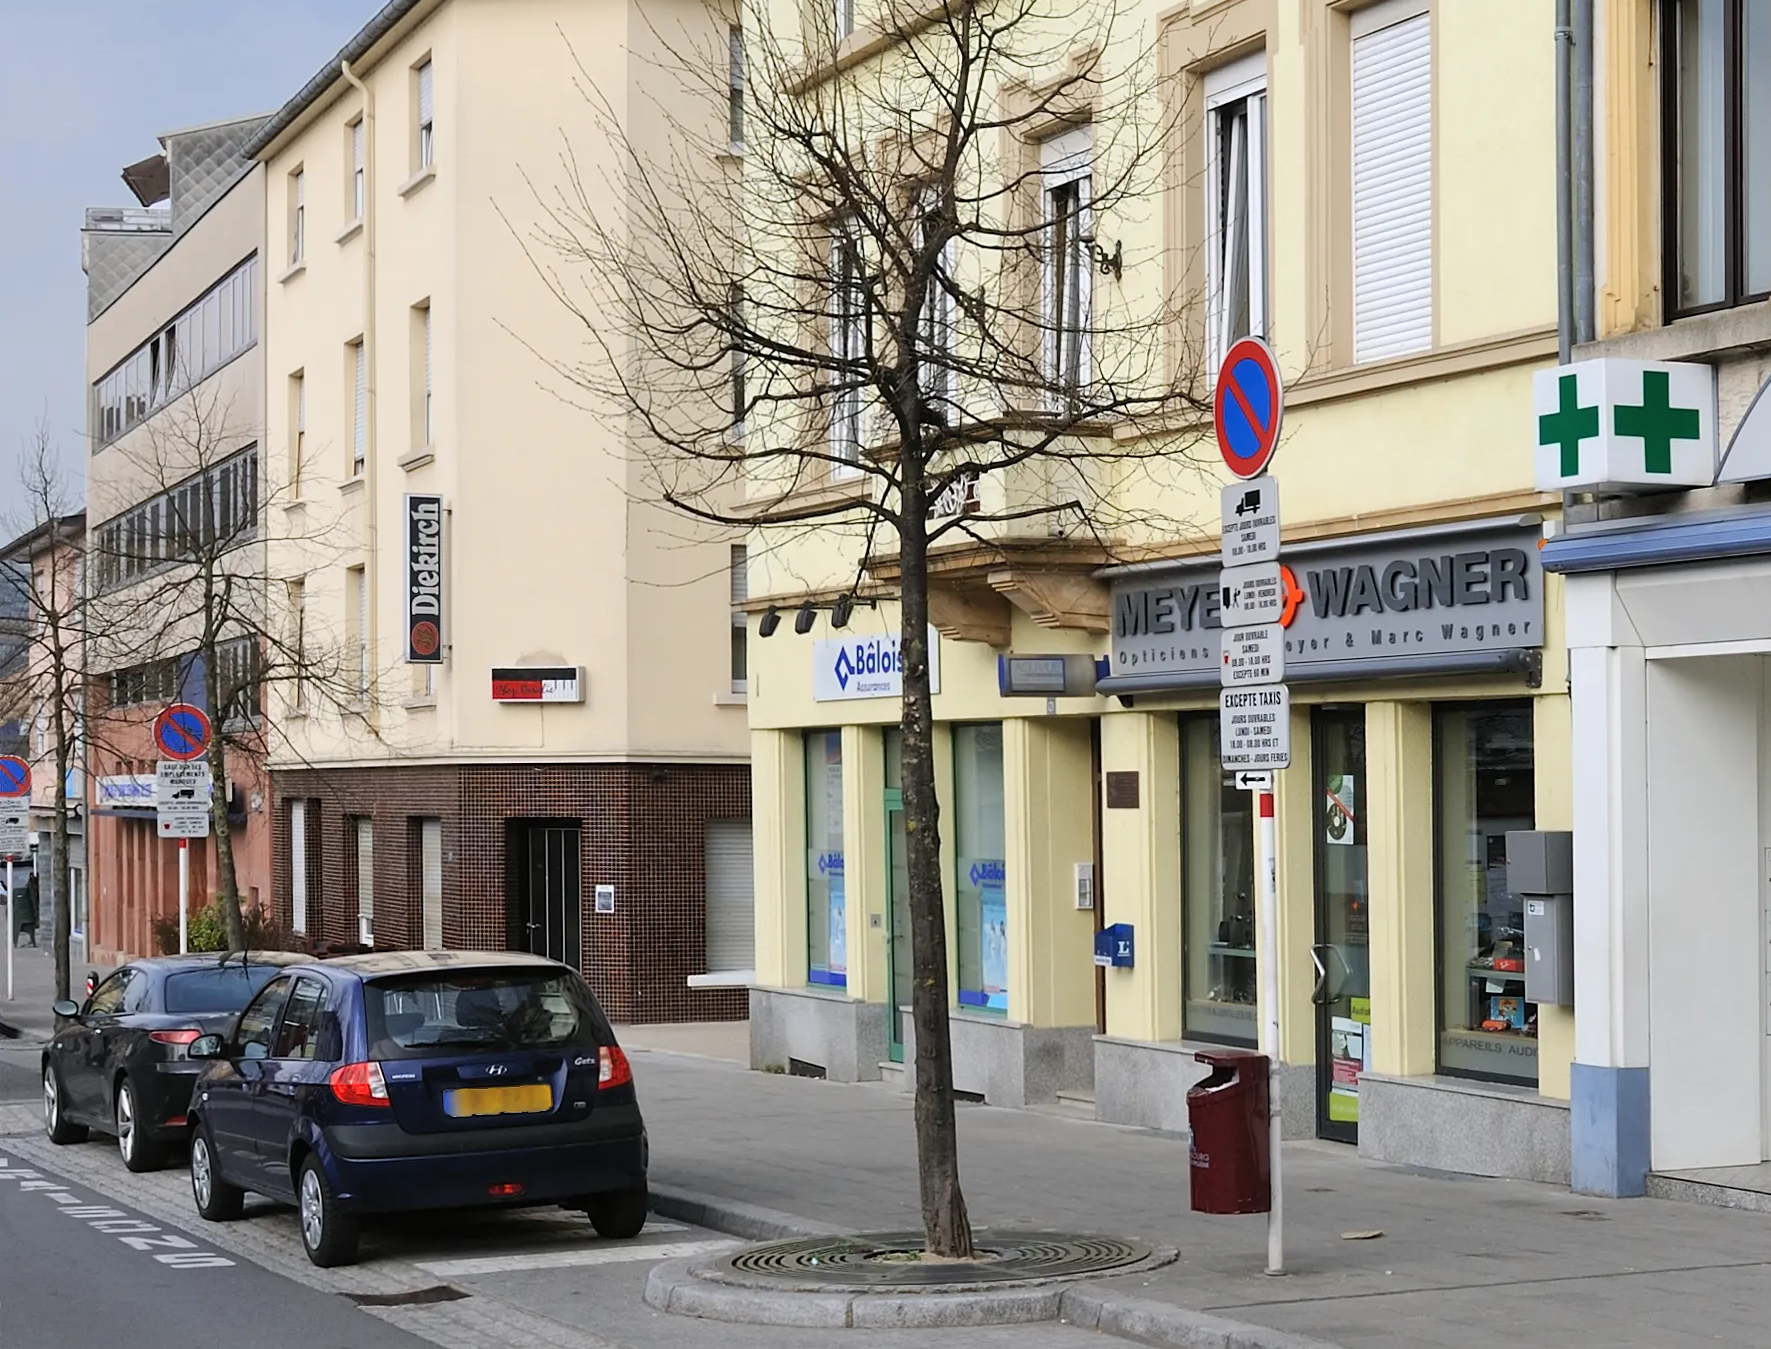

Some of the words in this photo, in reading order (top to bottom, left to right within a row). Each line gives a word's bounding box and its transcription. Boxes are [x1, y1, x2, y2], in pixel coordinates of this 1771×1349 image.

[411, 502, 440, 616] Diekirch
[1117, 582, 1221, 637] MEYE
[1306, 548, 1530, 618] WAGNER
[1119, 646, 1209, 666] Opticiens
[1284, 637, 1330, 654] eyer
[1345, 631, 1354, 648] &
[1371, 628, 1424, 646] Marc
[1441, 620, 1531, 641] Wagner
[1242, 643, 1259, 654] SAMEDI
[855, 639, 903, 675] Bâlois
[1261, 654, 1271, 664] HRS
[1233, 669, 1252, 680] EXCEPTE
[1260, 667, 1270, 677] MIN
[856, 681, 891, 693] Assurances
[1225, 692, 1257, 708] EXCEPTE
[1258, 691, 1281, 706] TAXIS
[1231, 714, 1247, 724] JOURS
[1247, 712, 1276, 724] OUVRABLES
[1235, 726, 1250, 737] LUNDI
[1253, 725, 1272, 736] SAMEDI
[1261, 738, 1272, 748] HRS
[1272, 737, 1279, 747] ET
[1222, 753, 1250, 764] DIMANCHES
[1253, 753, 1270, 762] JOURS
[1270, 752, 1288, 762] FERIES
[828, 853, 844, 870] Bâlo
[981, 862, 1005, 882] Bâloi
[1442, 1035, 1503, 1054] APPAREILS
[1508, 1044, 1538, 1058] AUDI
